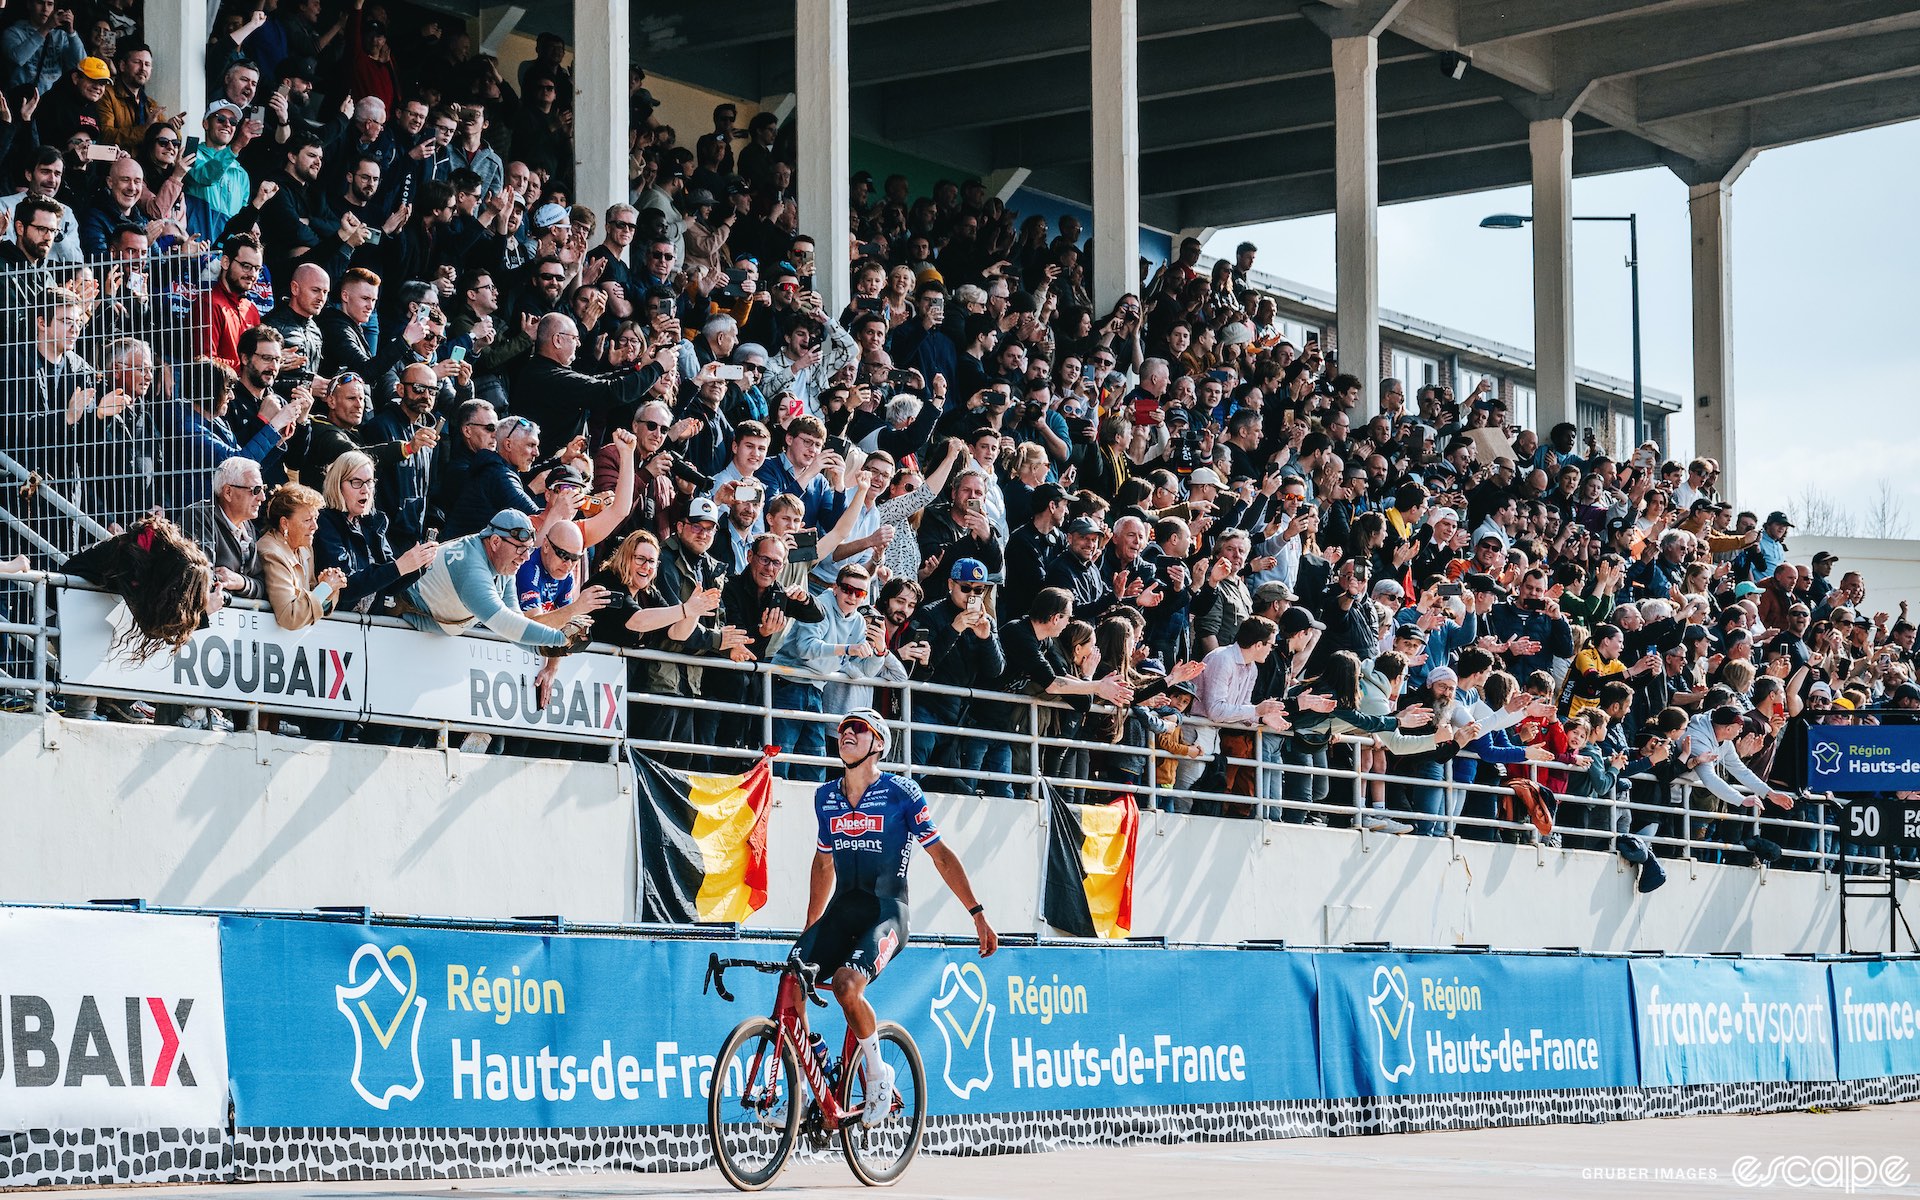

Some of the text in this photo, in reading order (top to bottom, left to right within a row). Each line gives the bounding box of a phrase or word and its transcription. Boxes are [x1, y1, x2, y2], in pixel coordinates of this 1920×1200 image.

[239, 614, 258, 630] DE
[174, 635, 353, 701] ROUBAIX
[469, 644, 540, 667] VILLE DE
[469, 668, 624, 731] ROUBAIX
[1561, 681, 1576, 704] HEMA
[1849, 745, 1891, 758] Région
[835, 817, 876, 830] Alpecin
[1850, 806, 1881, 837] 50
[834, 839, 883, 851] Elegant
[897, 831, 913, 878] Elegant
[447, 964, 566, 1025] Région
[1008, 974, 1088, 1025] Région
[1421, 976, 1482, 1019] Région
[0, 995, 197, 1087] BAIX
[794, 1016, 827, 1103] CANYON
[1011, 1033, 1246, 1089] Hauts-de-France
[1426, 1028, 1599, 1074] Hauts-de-France
[451, 1038, 784, 1102] Hauts-de-France
